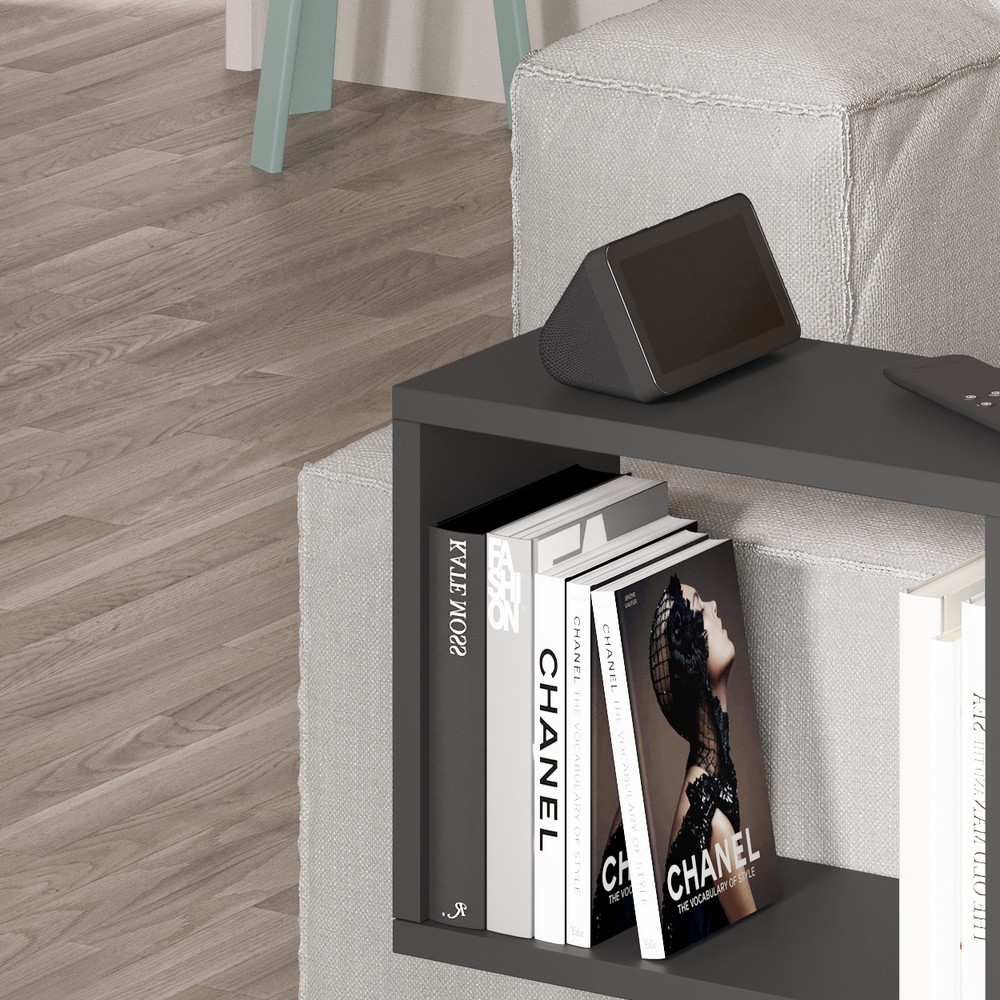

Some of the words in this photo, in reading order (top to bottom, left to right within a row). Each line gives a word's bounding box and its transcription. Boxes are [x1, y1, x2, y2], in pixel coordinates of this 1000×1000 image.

[572, 615, 582, 685] CHANEL
[602, 623, 618, 693] CHANEL
[573, 691, 582, 717] THE
[613, 698, 624, 727] THE
[538, 648, 559, 851] CHANEL
[573, 721, 582, 823] VOCABULARY
[617, 729, 638, 833] VOCABULARY
[573, 826, 582, 846] OF
[631, 837, 642, 857] OF
[573, 850, 582, 896] STYLE
[635, 861, 649, 907] STYLE
[667, 827, 760, 901] CHANEL
[608, 890, 620, 905] THE
[677, 900, 690, 914] THE
[689, 881, 728, 908] VOCABULARY
[729, 875, 737, 888] OF
[738, 866, 756, 883] STYLE
